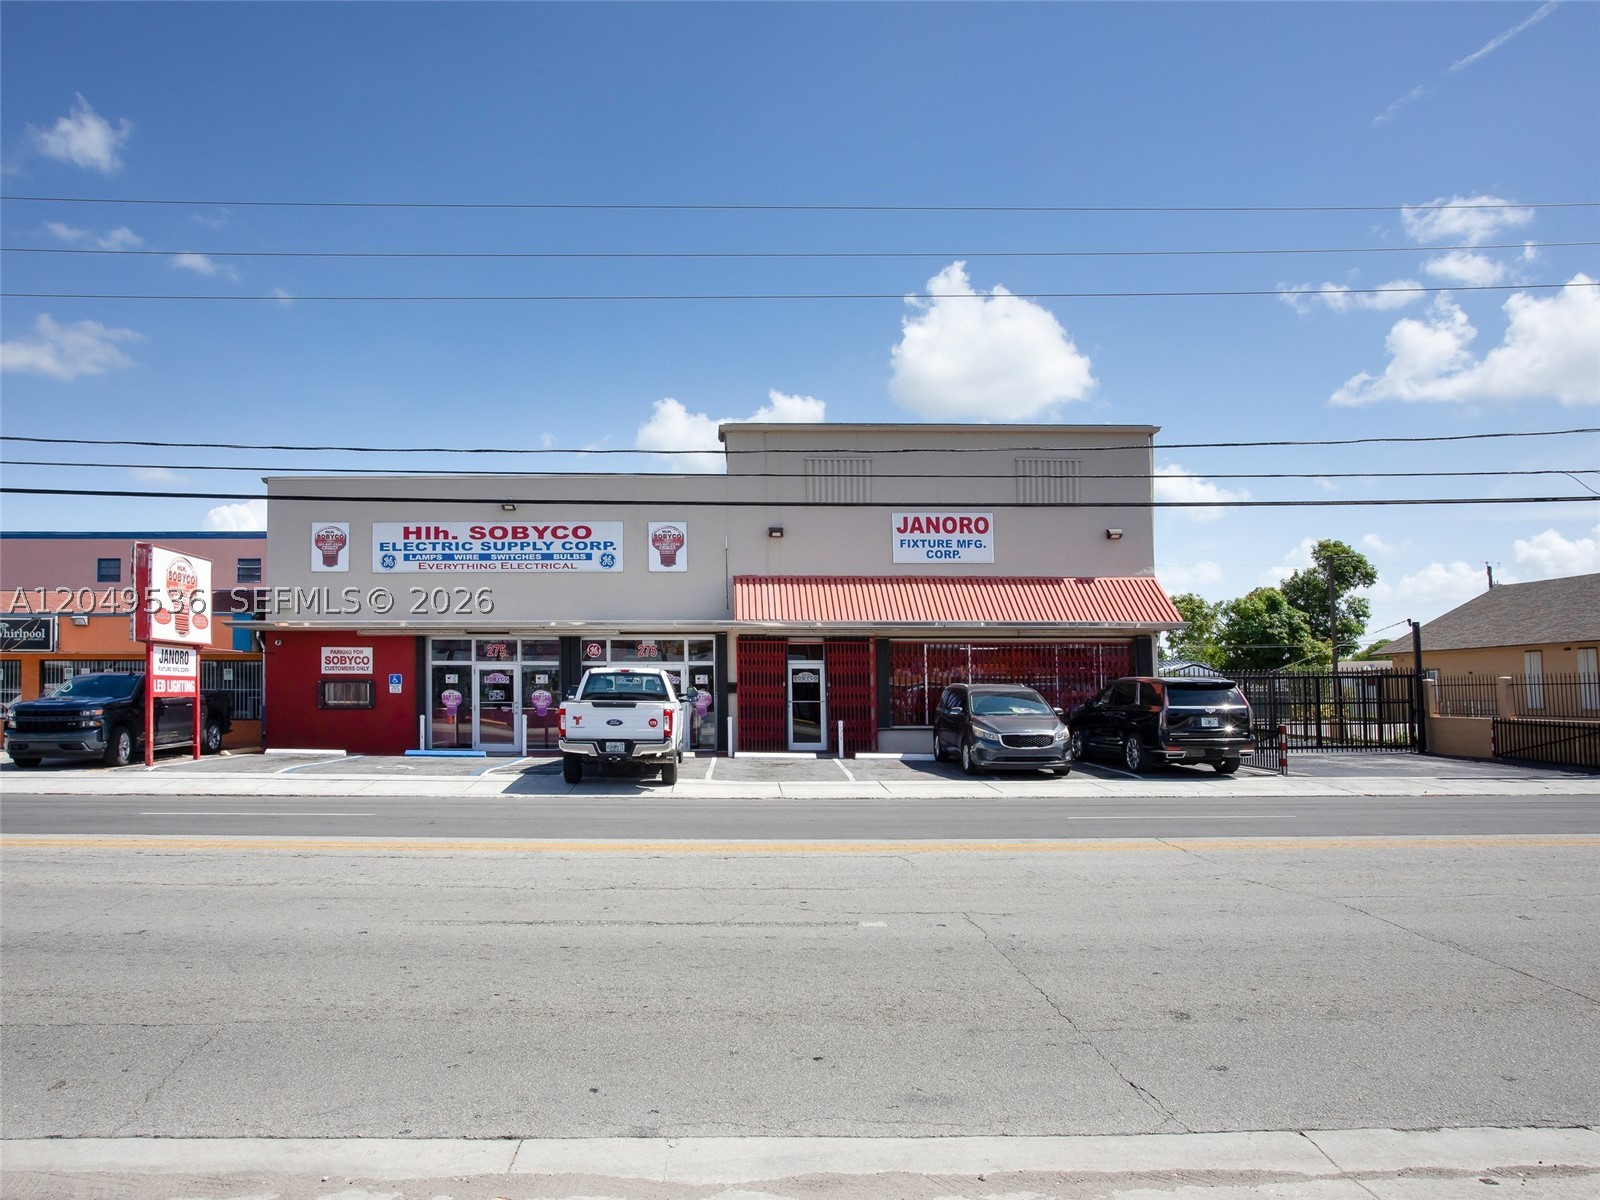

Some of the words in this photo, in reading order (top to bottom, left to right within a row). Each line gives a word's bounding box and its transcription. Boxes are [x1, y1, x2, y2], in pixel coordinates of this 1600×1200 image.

[896, 516, 990, 535] JANORO
[469, 525, 593, 541] SOBYCO
[379, 541, 475, 552] ELECTRIC
[480, 541, 554, 552] SUPPLY
[561, 540, 617, 551] CORP.
[900, 539, 953, 549] FIXTURE
[956, 539, 987, 549] MFG.
[926, 549, 961, 559] CORP.
[418, 562, 497, 570] EVERYTHING
[500, 562, 578, 570] ELECTRICAL
[168, 570, 196, 585] SOBYCO
[159, 648, 189, 665] JANORO
[487, 643, 507, 657] 275
[637, 644, 658, 658] 275
[324, 656, 370, 665] SOBYCO
[153, 679, 166, 693] LED
[167, 679, 196, 693] LIGHTING
